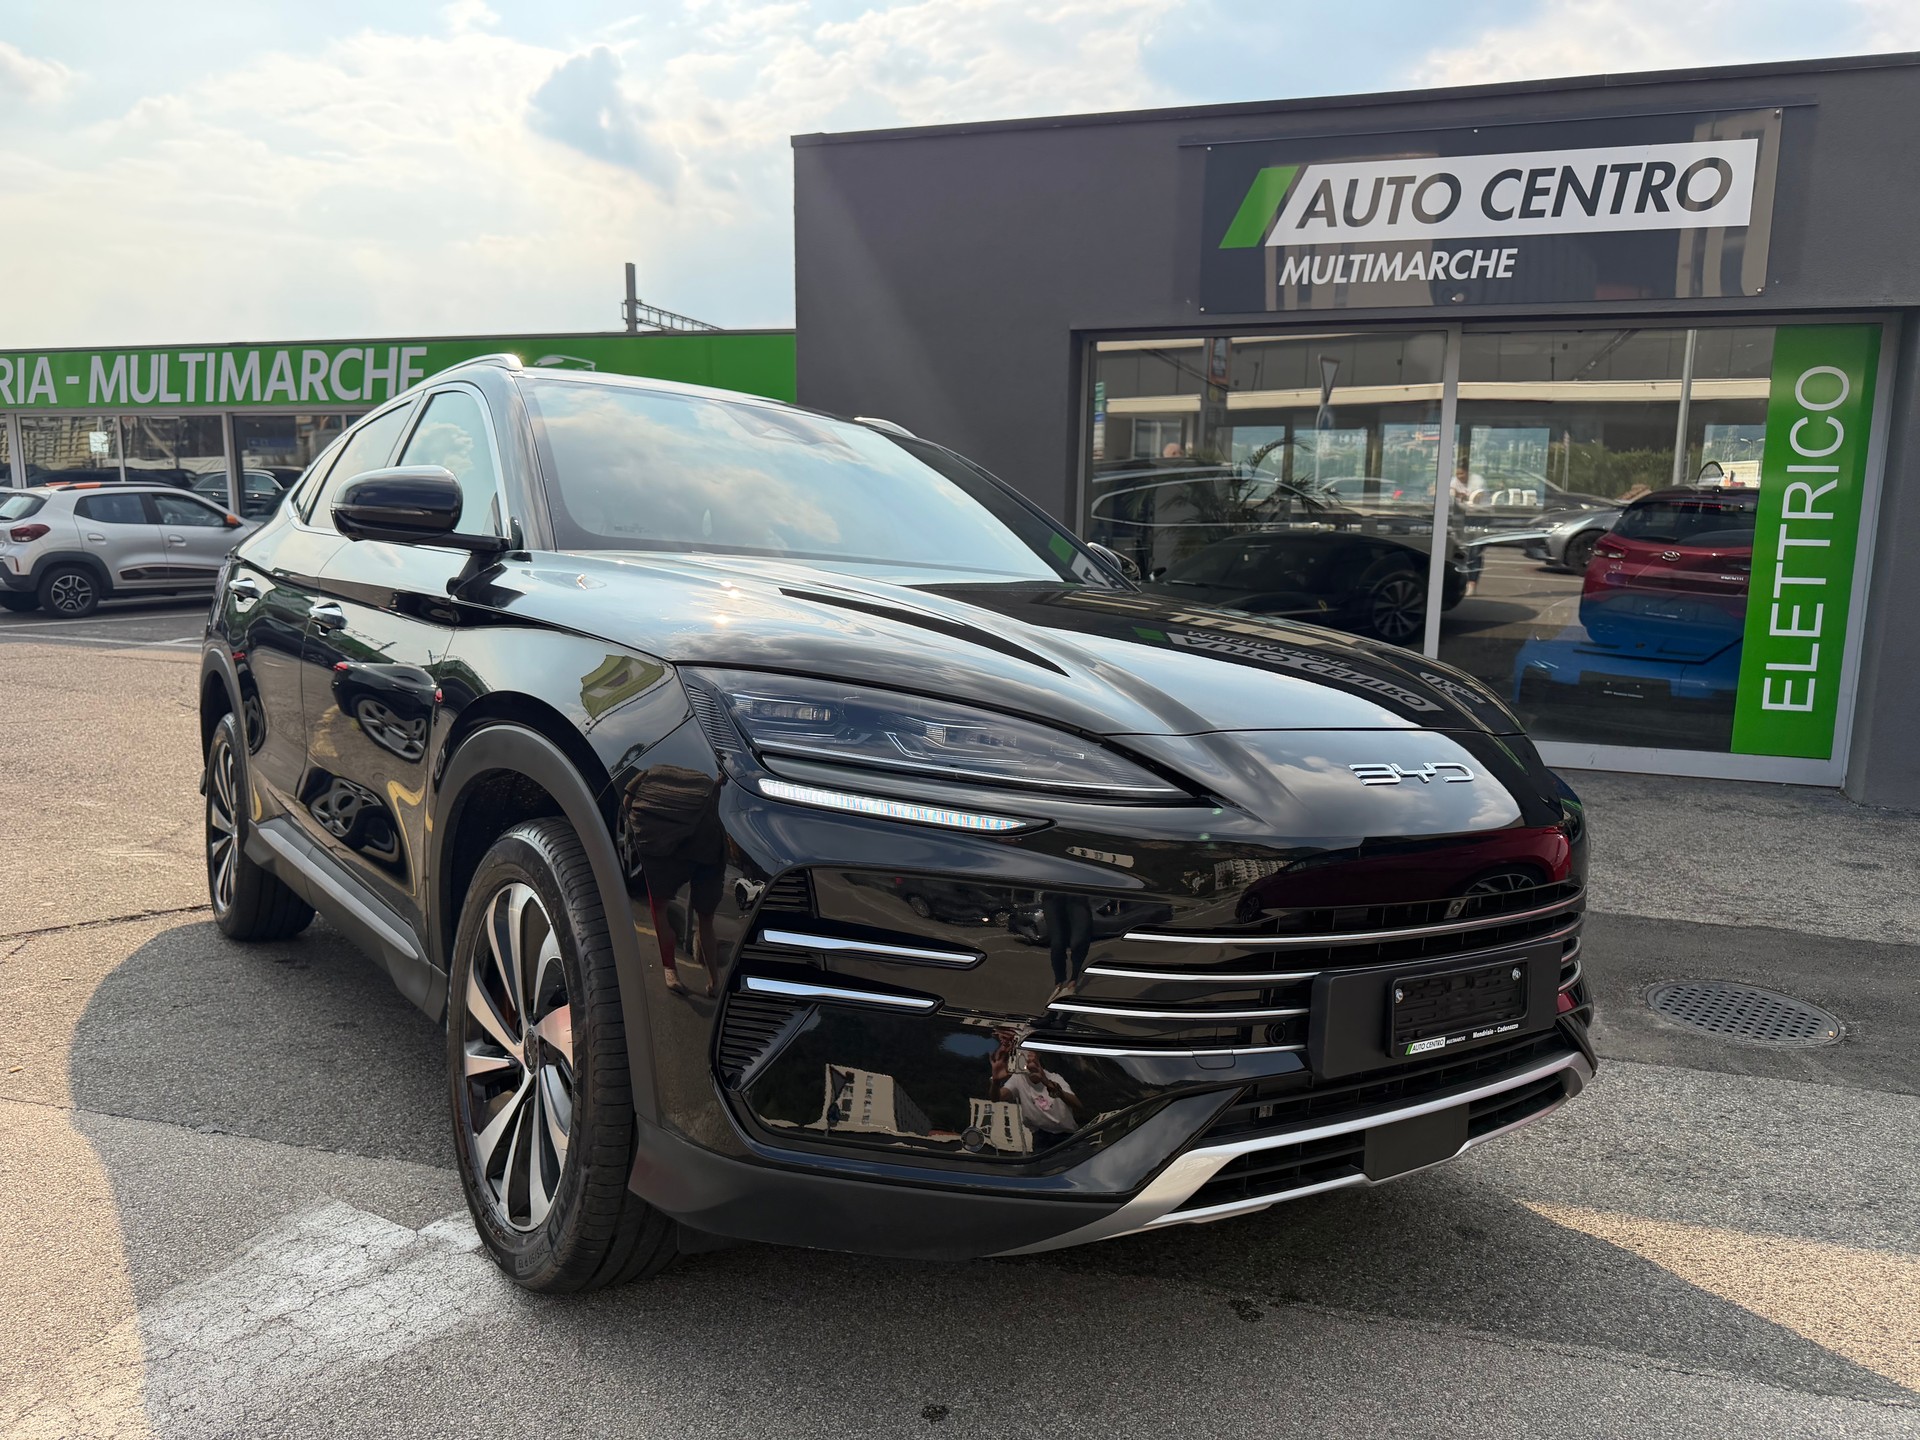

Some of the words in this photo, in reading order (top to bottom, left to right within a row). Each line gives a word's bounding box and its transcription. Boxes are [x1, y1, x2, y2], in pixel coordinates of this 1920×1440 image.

[1295, 172, 1462, 230] AUTO
[1480, 156, 1734, 222] CENTRO
[1278, 247, 1519, 286] MULTIMARCHE
[0, 357, 57, 405] RIA
[87, 346, 428, 404] MULTIMARCHE
[1761, 365, 1850, 712] ELETTRICO
[1348, 762, 1475, 786] BYD
[1412, 1042, 1425, 1052] AUTO
[1426, 1038, 1444, 1049] CENTRO
